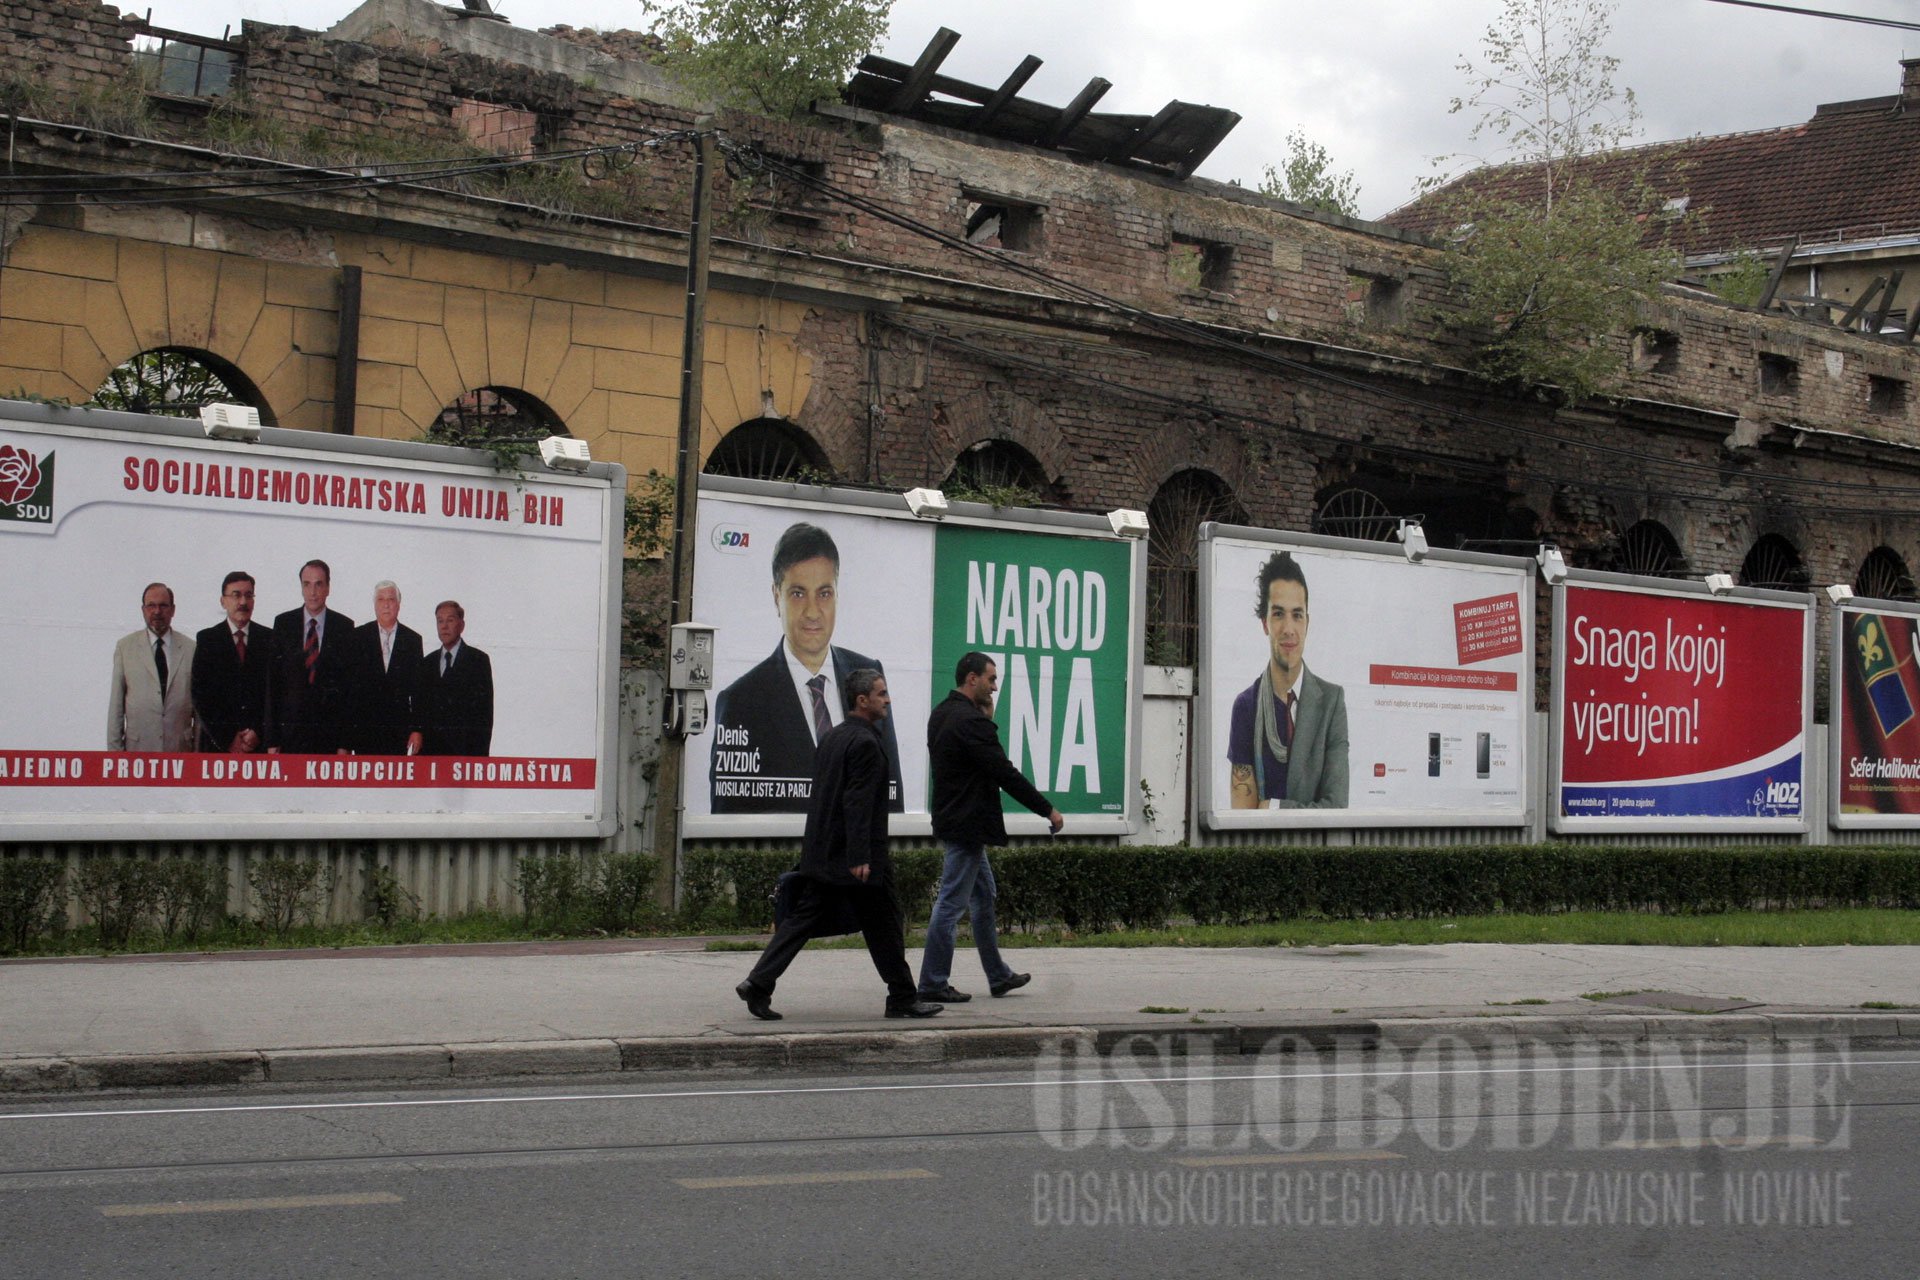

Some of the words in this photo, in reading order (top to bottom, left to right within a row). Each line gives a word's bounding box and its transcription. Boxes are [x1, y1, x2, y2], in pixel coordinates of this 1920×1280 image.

[124, 456, 426, 514] SOCIJALDEMOKRATSKA
[442, 486, 509, 521] UNIJA
[524, 494, 563, 526] BIH
[17, 503, 50, 520] SDU
[721, 531, 750, 547] SDA
[966, 560, 1107, 651] NAROD
[1459, 605, 1492, 619] KOMBINUJ
[1492, 601, 1514, 612] TARIFA
[1573, 615, 1656, 683] Snaga
[1665, 617, 1726, 688] kojoj
[1391, 670, 1426, 681] Kombinacija
[1427, 672, 1440, 682] koja
[1440, 673, 1466, 683] svakome
[1466, 674, 1484, 684] dobro
[1572, 689, 1699, 756] vjerujem!
[716, 724, 749, 746] Denis
[102, 758, 184, 779] PROTIV
[202, 759, 288, 782] LOPOVA,
[306, 761, 415, 780] KORUPCIJE
[430, 762, 436, 780] I
[453, 760, 572, 782] SIROMAŠTVA
[715, 747, 761, 773] ZVIZDIĆ
[1849, 756, 1876, 778] Sefer
[715, 781, 750, 797] NOSILAC
[751, 782, 774, 797] LISTE
[775, 783, 786, 797] ZA
[1766, 782, 1800, 803] HDZ
